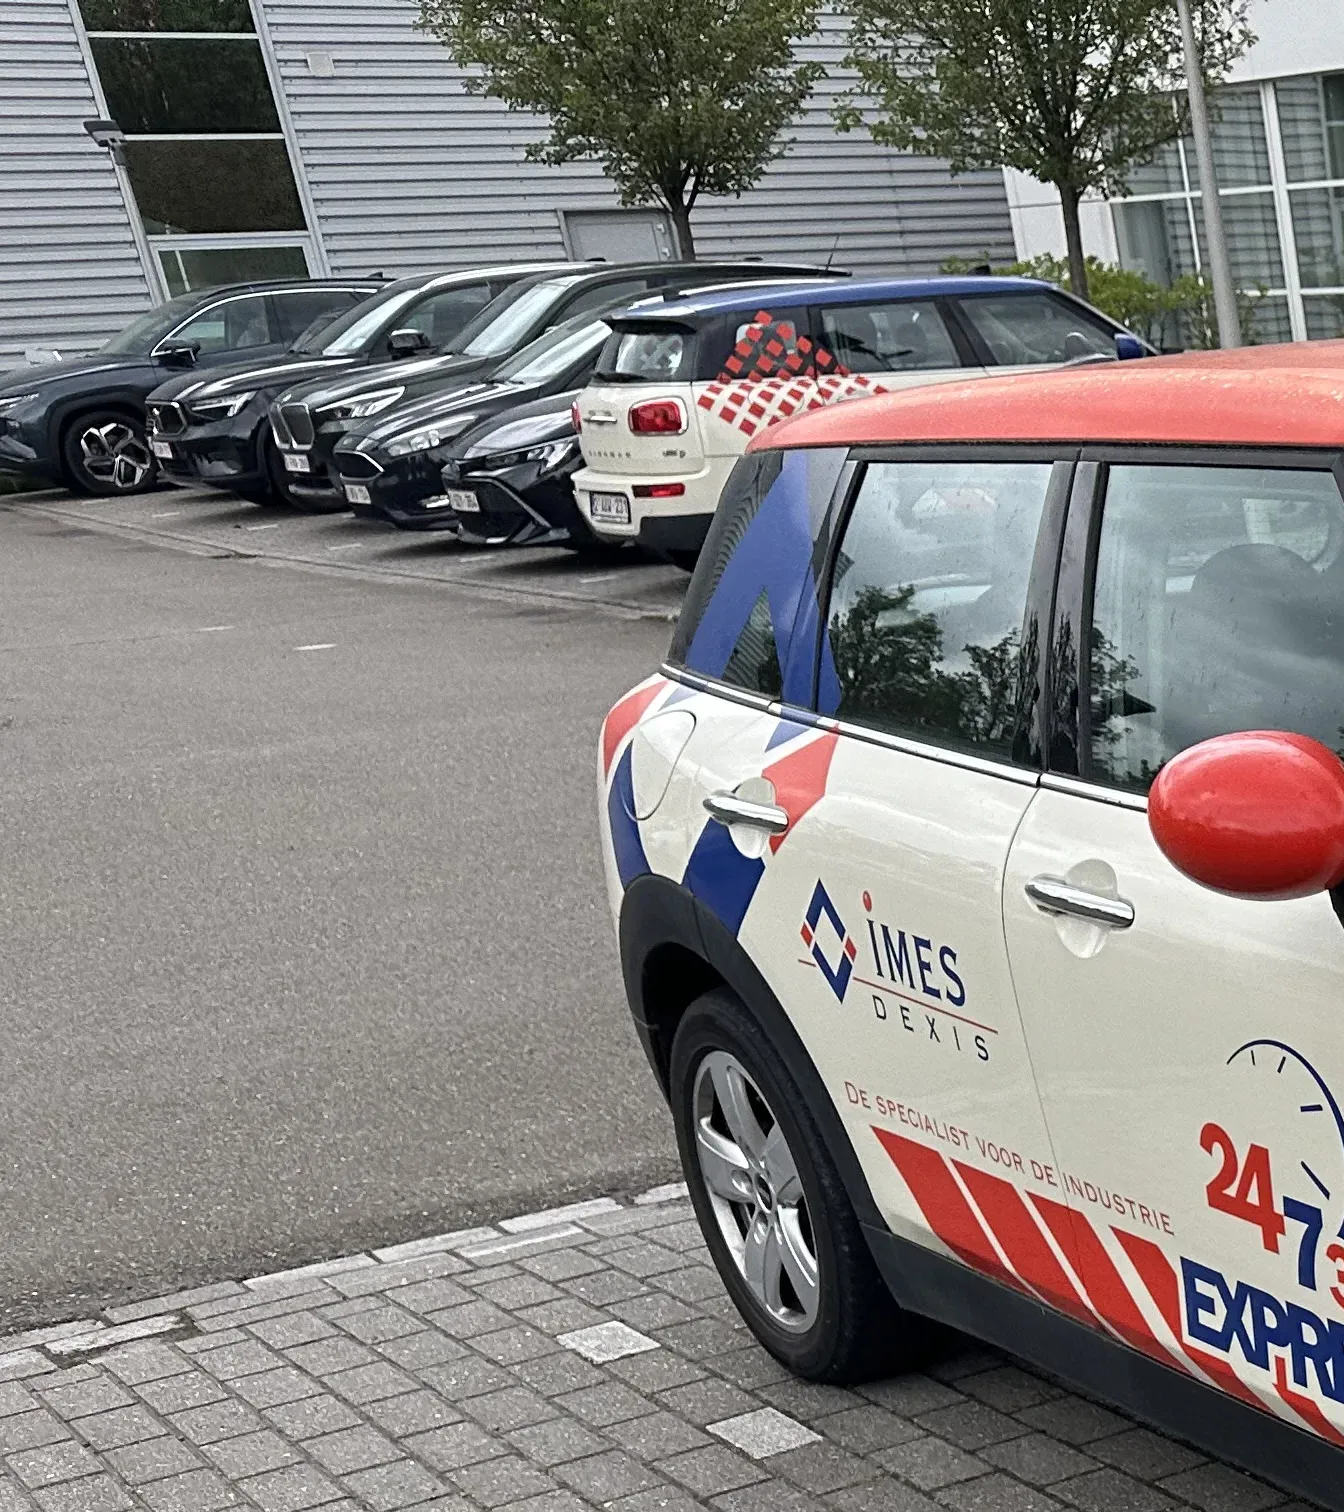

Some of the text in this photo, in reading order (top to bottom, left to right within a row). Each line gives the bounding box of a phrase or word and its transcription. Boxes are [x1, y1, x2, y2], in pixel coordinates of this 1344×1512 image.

[872, 994, 989, 1061] DEXIS
[844, 1081, 1175, 1236] DE SPECIALIST VOOR DE INDUSTRIE
